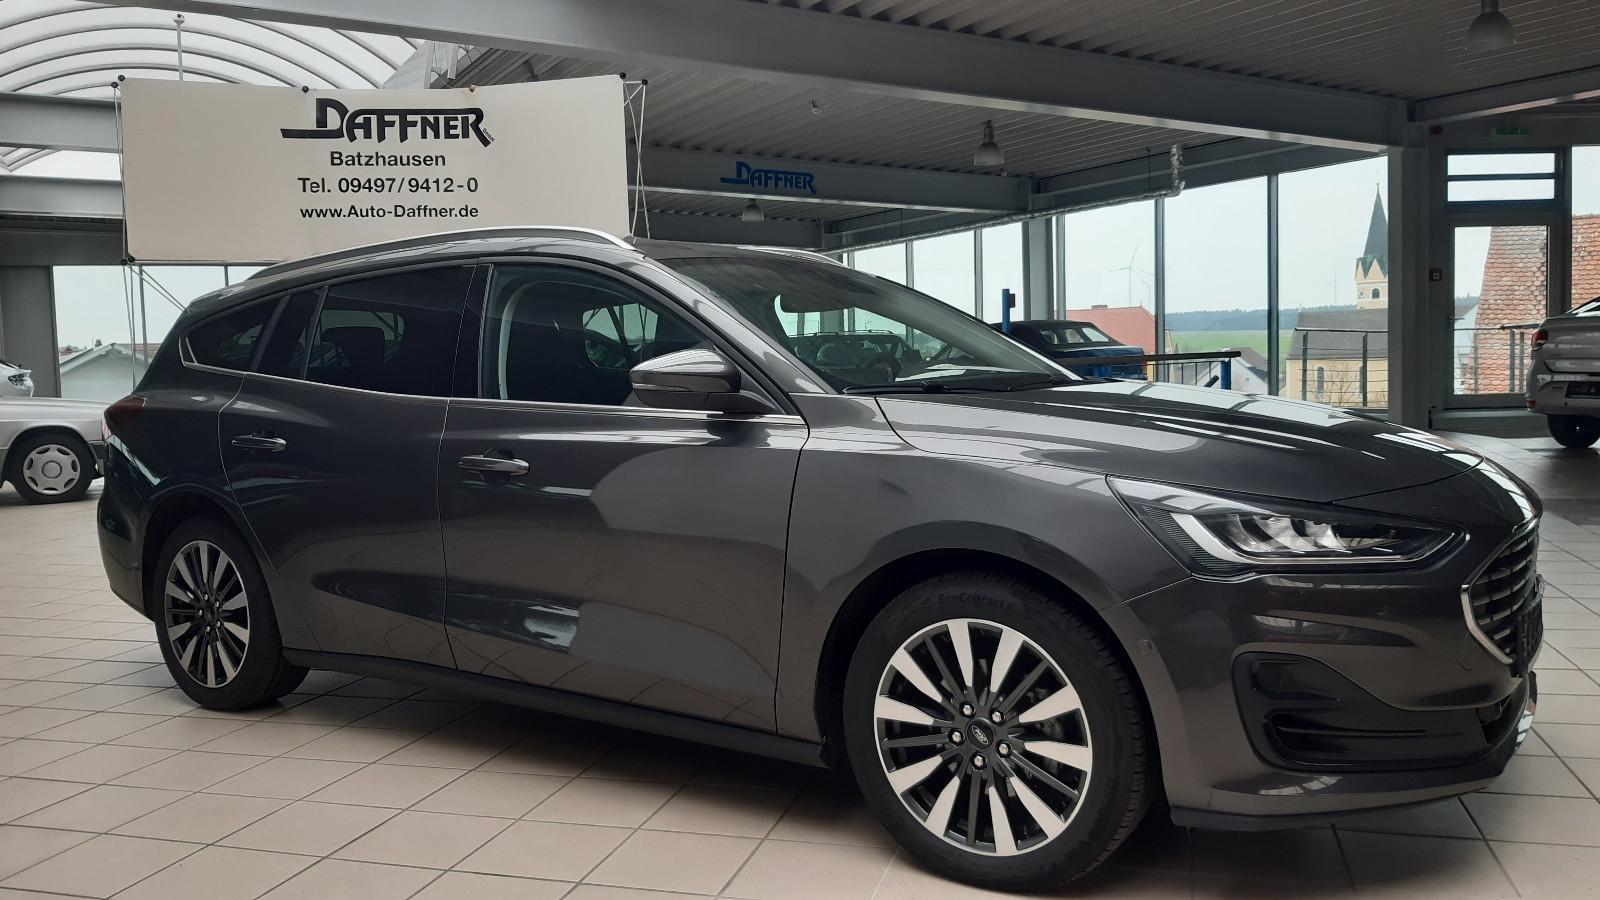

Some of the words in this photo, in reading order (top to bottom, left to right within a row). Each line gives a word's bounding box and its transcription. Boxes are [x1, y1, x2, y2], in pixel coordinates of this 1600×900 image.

[280, 98, 494, 148] DAFFNER
[329, 151, 446, 167] Batzhausen
[297, 177, 332, 194] Tel.
[720, 161, 817, 194] DAFFNER
[299, 205, 480, 219] www.Auto-Daffner.de
